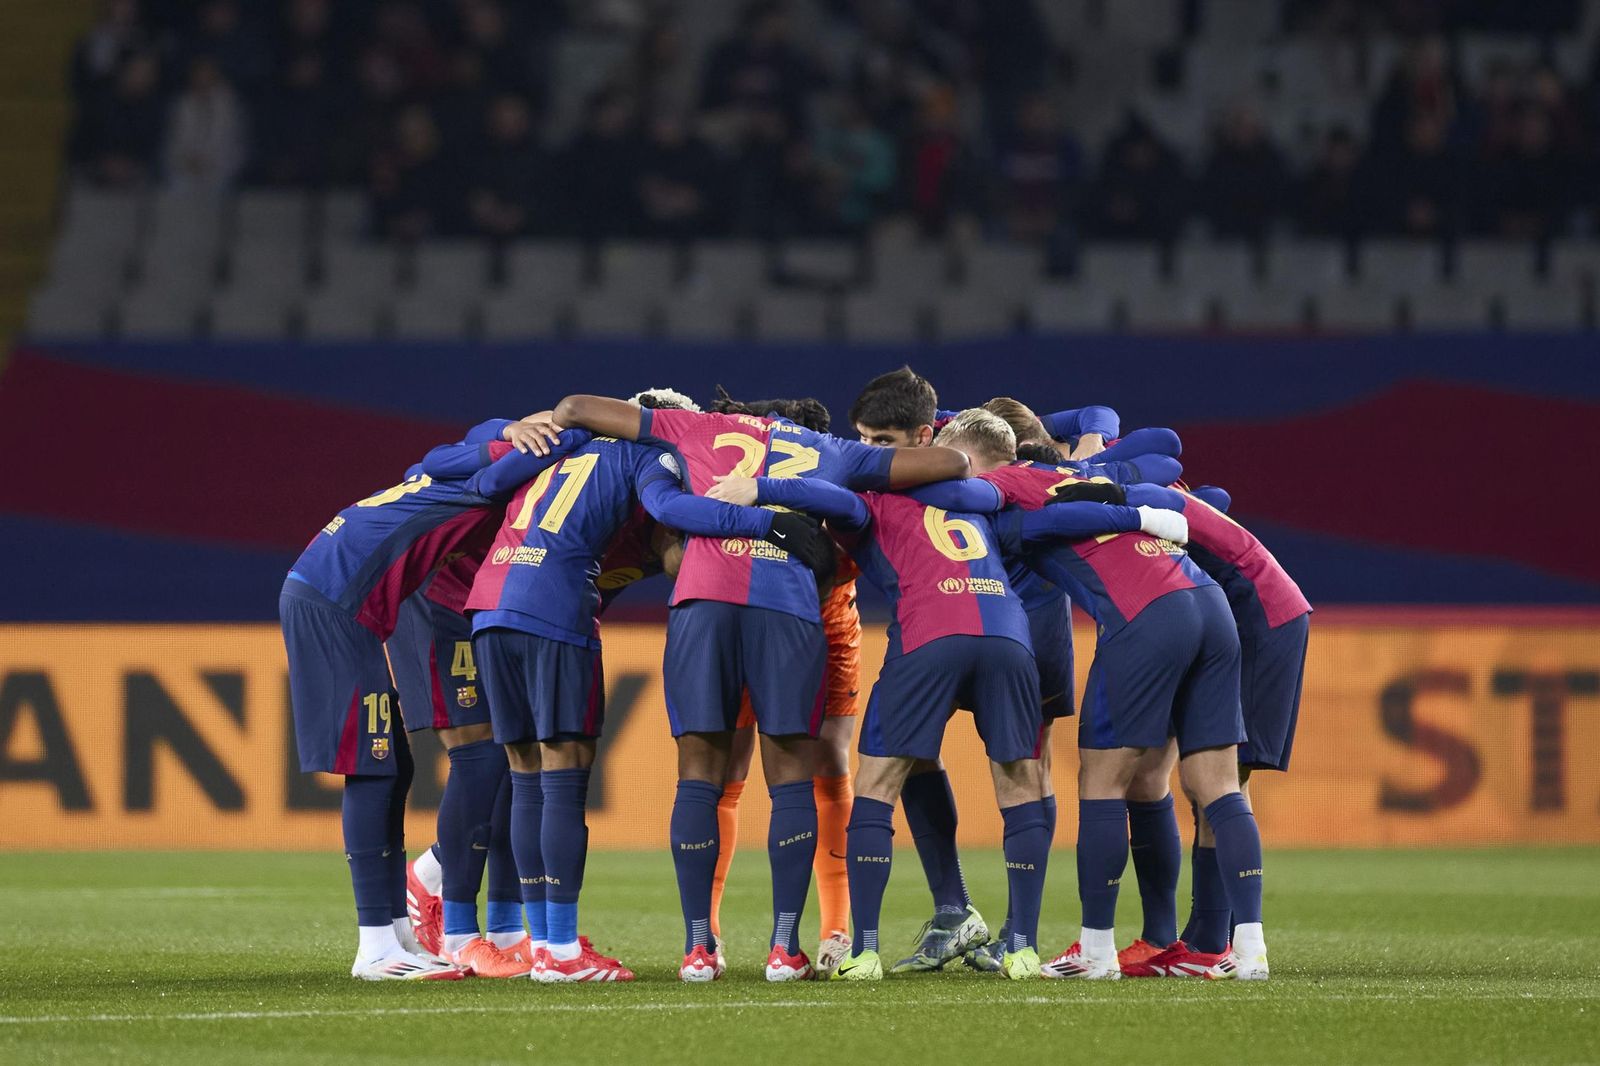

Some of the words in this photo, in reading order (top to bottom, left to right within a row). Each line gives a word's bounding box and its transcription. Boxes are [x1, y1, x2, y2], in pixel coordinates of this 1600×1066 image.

[510, 453, 601, 534] 11
[749, 539, 780, 550] UNH
[924, 505, 988, 561] 6
[510, 553, 543, 563] ACNUR
[515, 545, 547, 556] UNHCR
[749, 547, 789, 560] ACNUR
[451, 641, 477, 681] 4
[363, 692, 392, 734] 19
